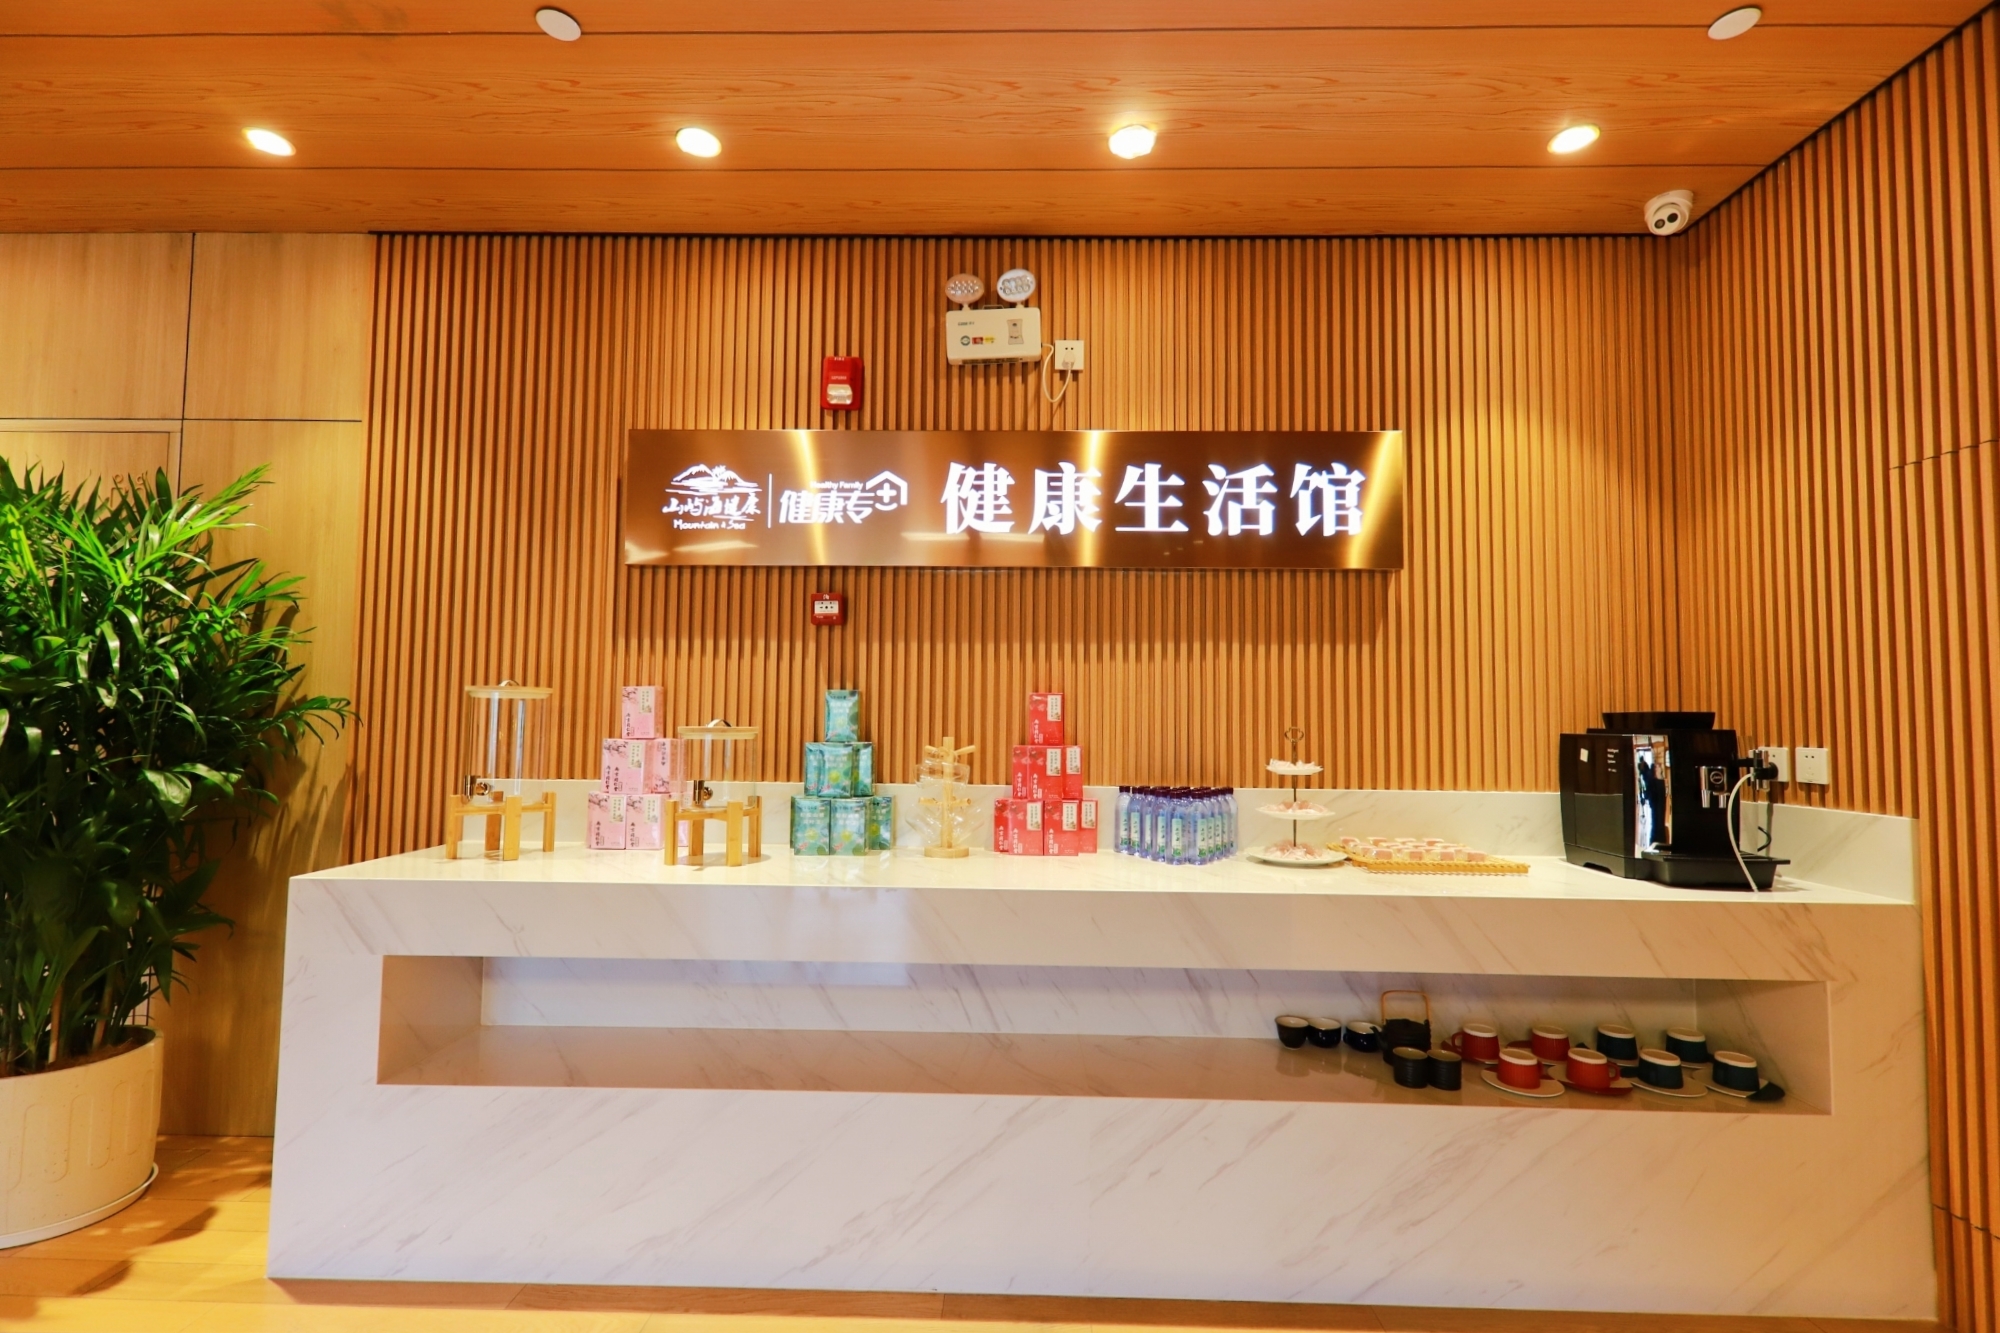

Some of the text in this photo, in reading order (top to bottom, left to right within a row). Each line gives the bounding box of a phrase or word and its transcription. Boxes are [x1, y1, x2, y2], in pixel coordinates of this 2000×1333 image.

[839, 481, 863, 491] Family
[940, 461, 1366, 537] 健康生活馆
[673, 518, 719, 530] Mountain
[726, 519, 746, 530] Sea
